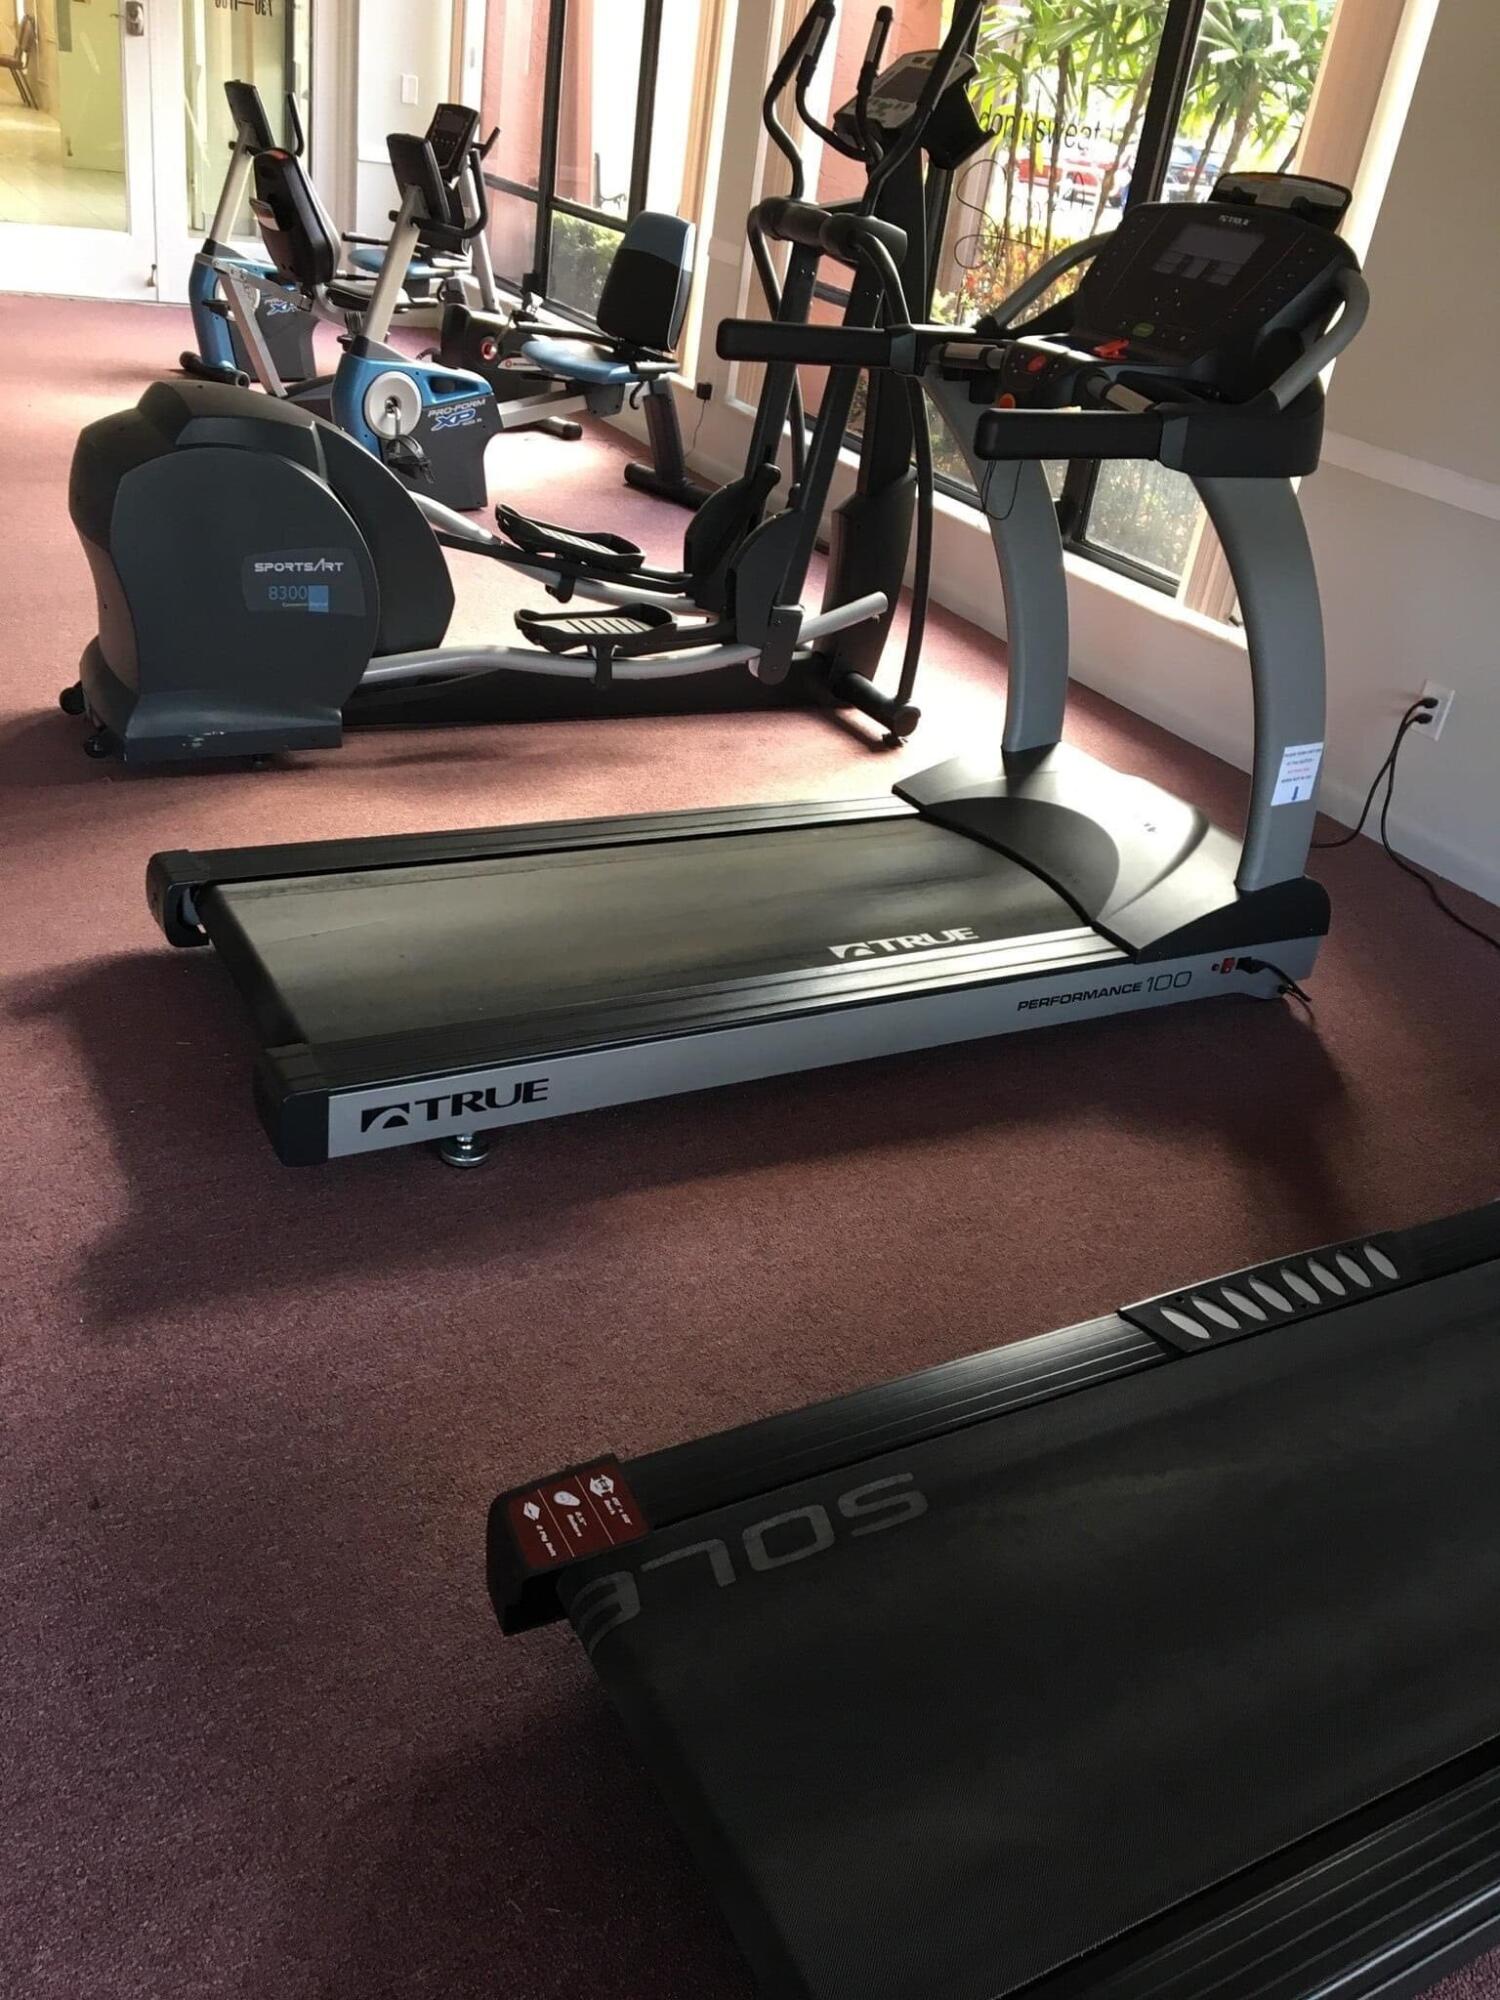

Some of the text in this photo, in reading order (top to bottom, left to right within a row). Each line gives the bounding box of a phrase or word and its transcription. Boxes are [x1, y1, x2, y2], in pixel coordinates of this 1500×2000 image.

[979, 104, 1028, 140] dont
[431, 408, 476, 431] XP
[254, 558, 344, 572] SPORTSART
[268, 585, 308, 601] 8300
[867, 927, 980, 952] TRUE
[1017, 971, 1192, 1011] PERFORMANCE 100
[414, 1078, 550, 1121] TRUE
[572, 1472, 929, 1656] SOLE
